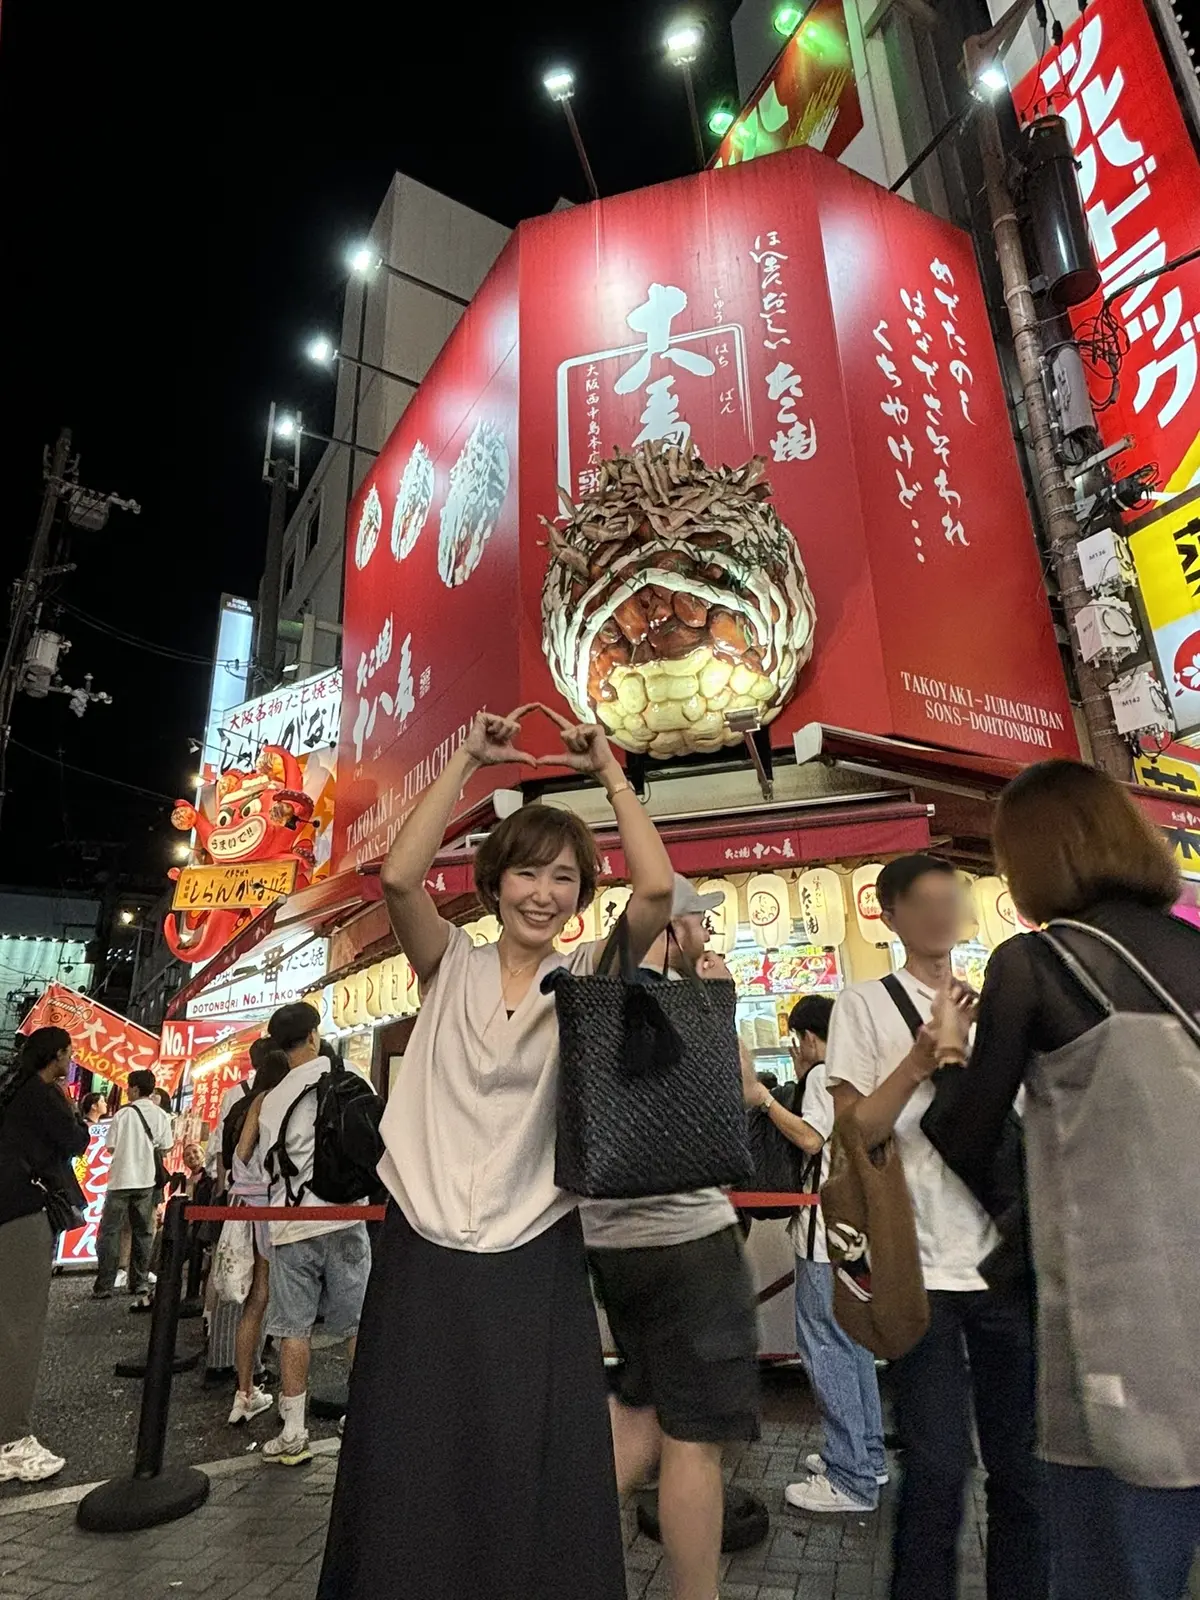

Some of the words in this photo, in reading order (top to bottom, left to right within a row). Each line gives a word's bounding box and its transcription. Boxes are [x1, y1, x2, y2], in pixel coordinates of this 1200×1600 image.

[900, 670, 1065, 731] TAKOYAKI-JUHACHIBAN
[925, 699, 1053, 749] SONS-DOHTONBORI
[192, 998, 239, 1015] DOTONBORI
[242, 991, 264, 1006] No.1
